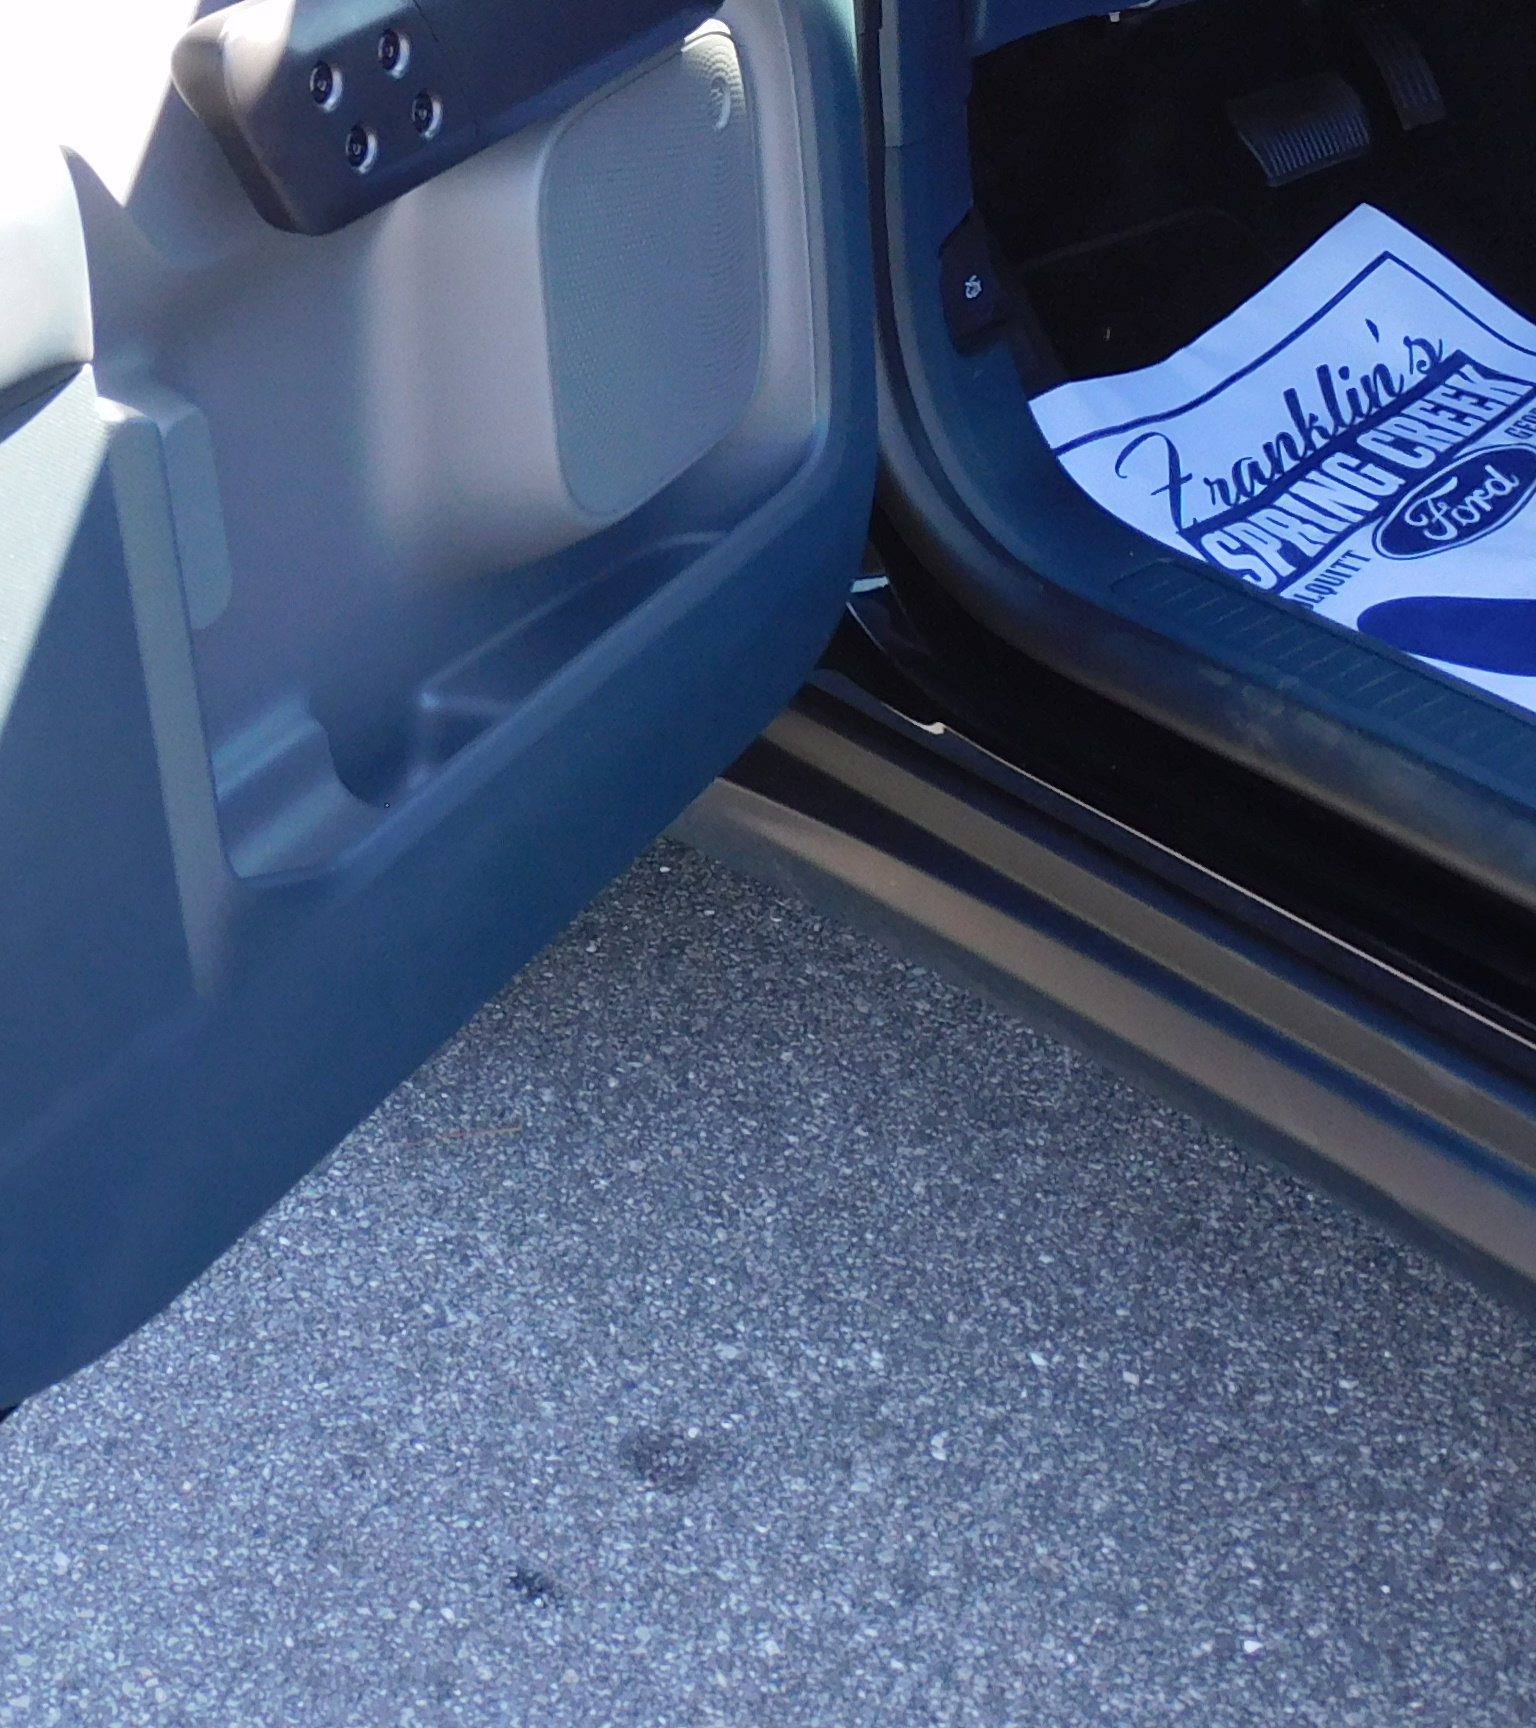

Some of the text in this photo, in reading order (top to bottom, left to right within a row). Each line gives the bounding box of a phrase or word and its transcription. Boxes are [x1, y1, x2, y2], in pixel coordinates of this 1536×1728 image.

[1114, 318, 1446, 532] Franklin's
[1201, 361, 1533, 591] SPRING CREEK
[1404, 464, 1520, 541] Ford
